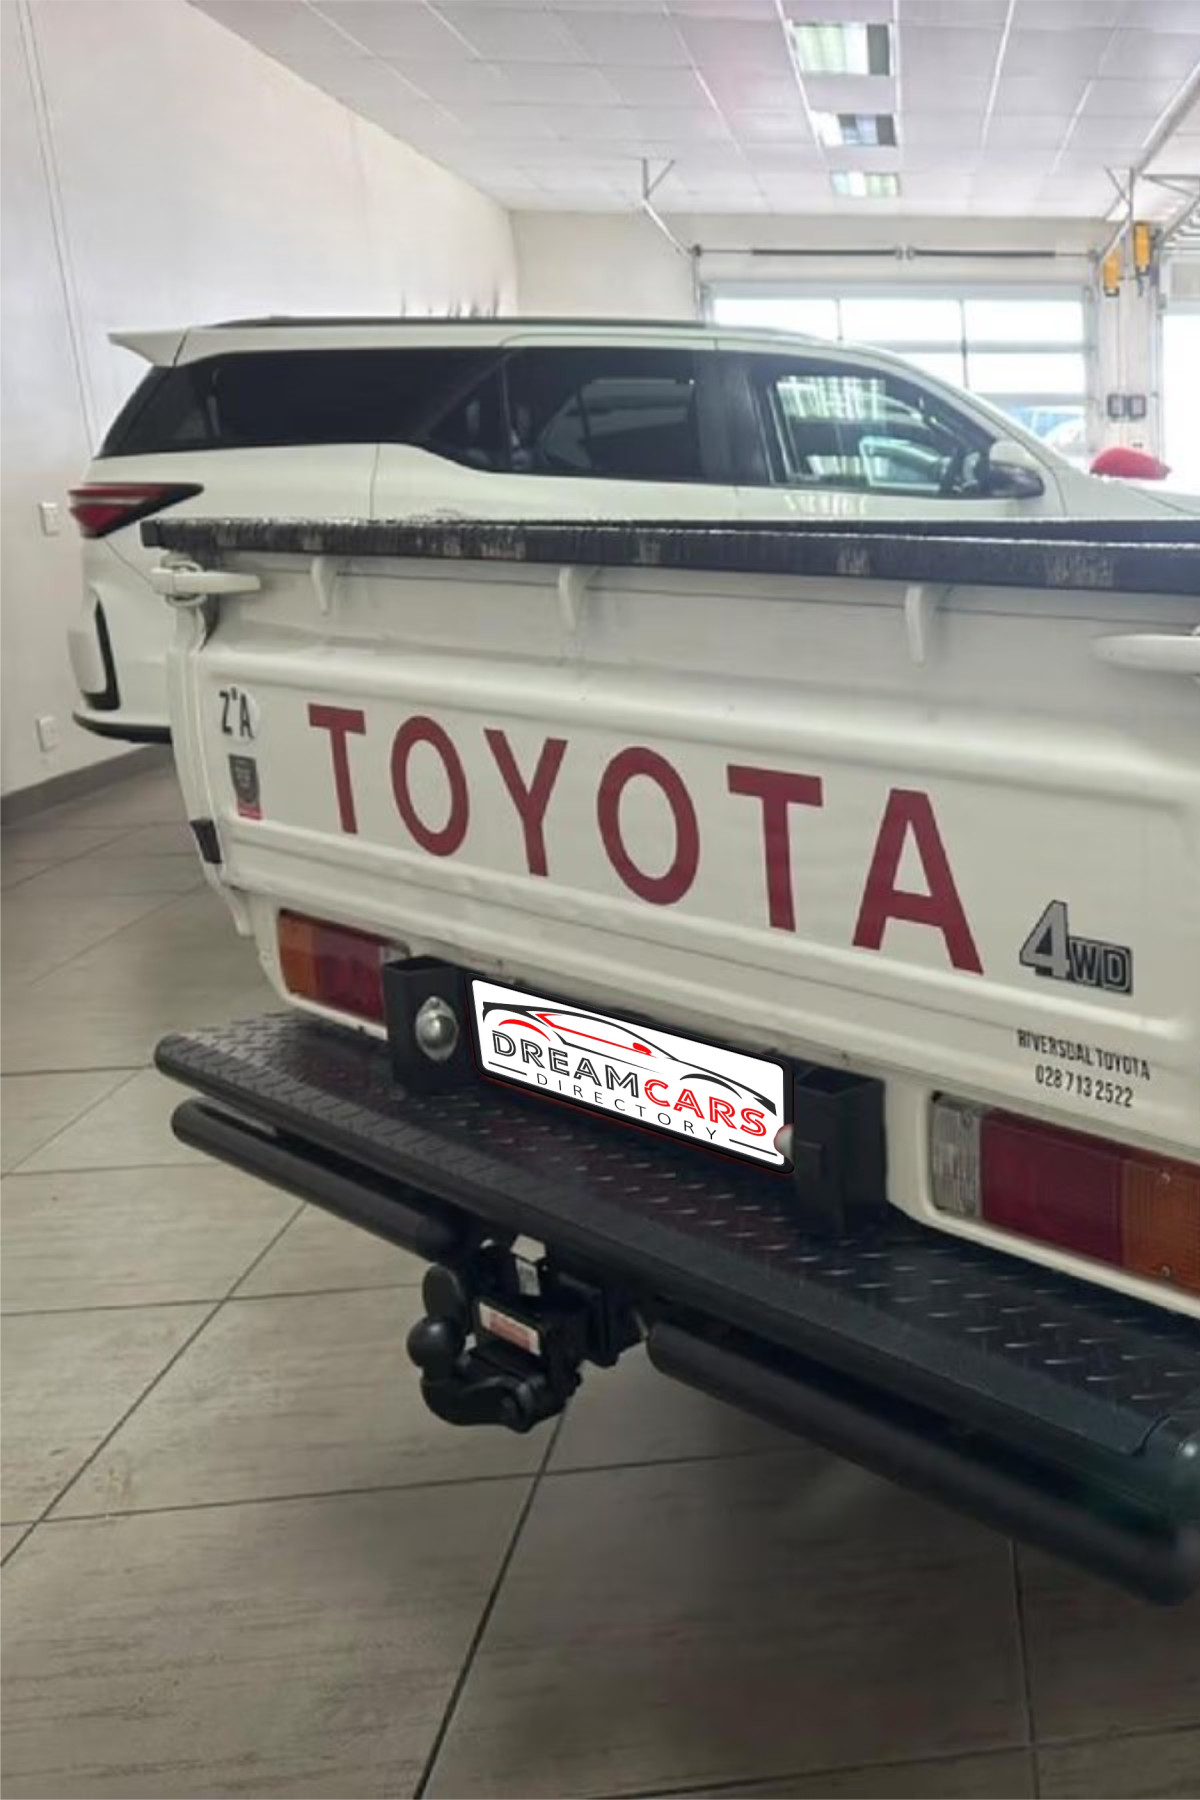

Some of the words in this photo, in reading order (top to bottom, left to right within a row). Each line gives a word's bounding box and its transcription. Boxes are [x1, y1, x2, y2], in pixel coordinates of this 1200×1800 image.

[308, 703, 984, 975] TOYOTA
[1019, 899, 1134, 996] 4WD
[1017, 1029, 1093, 1066] RIVERSDAL
[1096, 1048, 1151, 1081] TOYOTA
[1035, 1064, 1062, 1090] 028
[1066, 1071, 1092, 1098] 713
[1096, 1080, 1134, 1108] 2522
